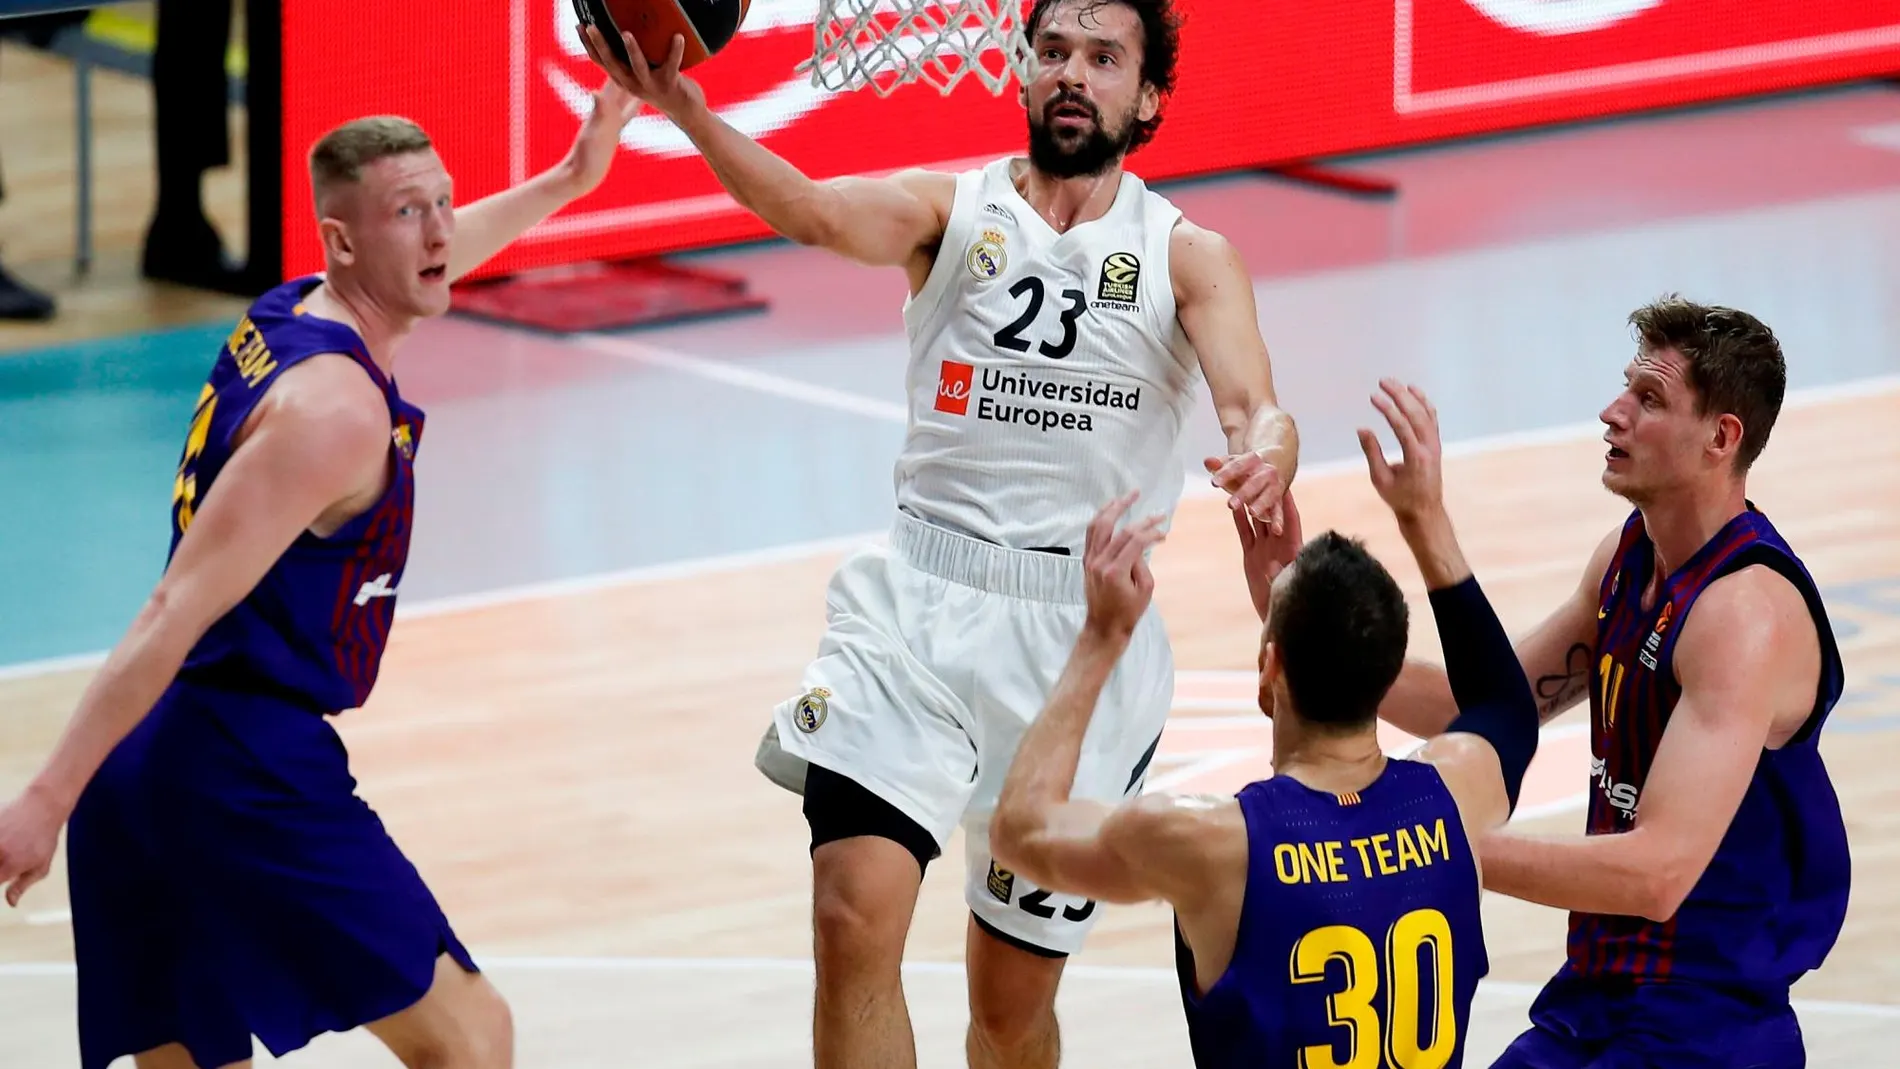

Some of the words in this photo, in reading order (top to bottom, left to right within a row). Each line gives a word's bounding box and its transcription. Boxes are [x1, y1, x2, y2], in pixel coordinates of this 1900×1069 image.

[993, 276, 1088, 359] 23
[977, 397, 1094, 432] Europea
[981, 368, 1141, 411] Universidad
[1273, 841, 1349, 885] ONE
[1350, 818, 1450, 878] TEAM
[1289, 908, 1457, 1069] 30
